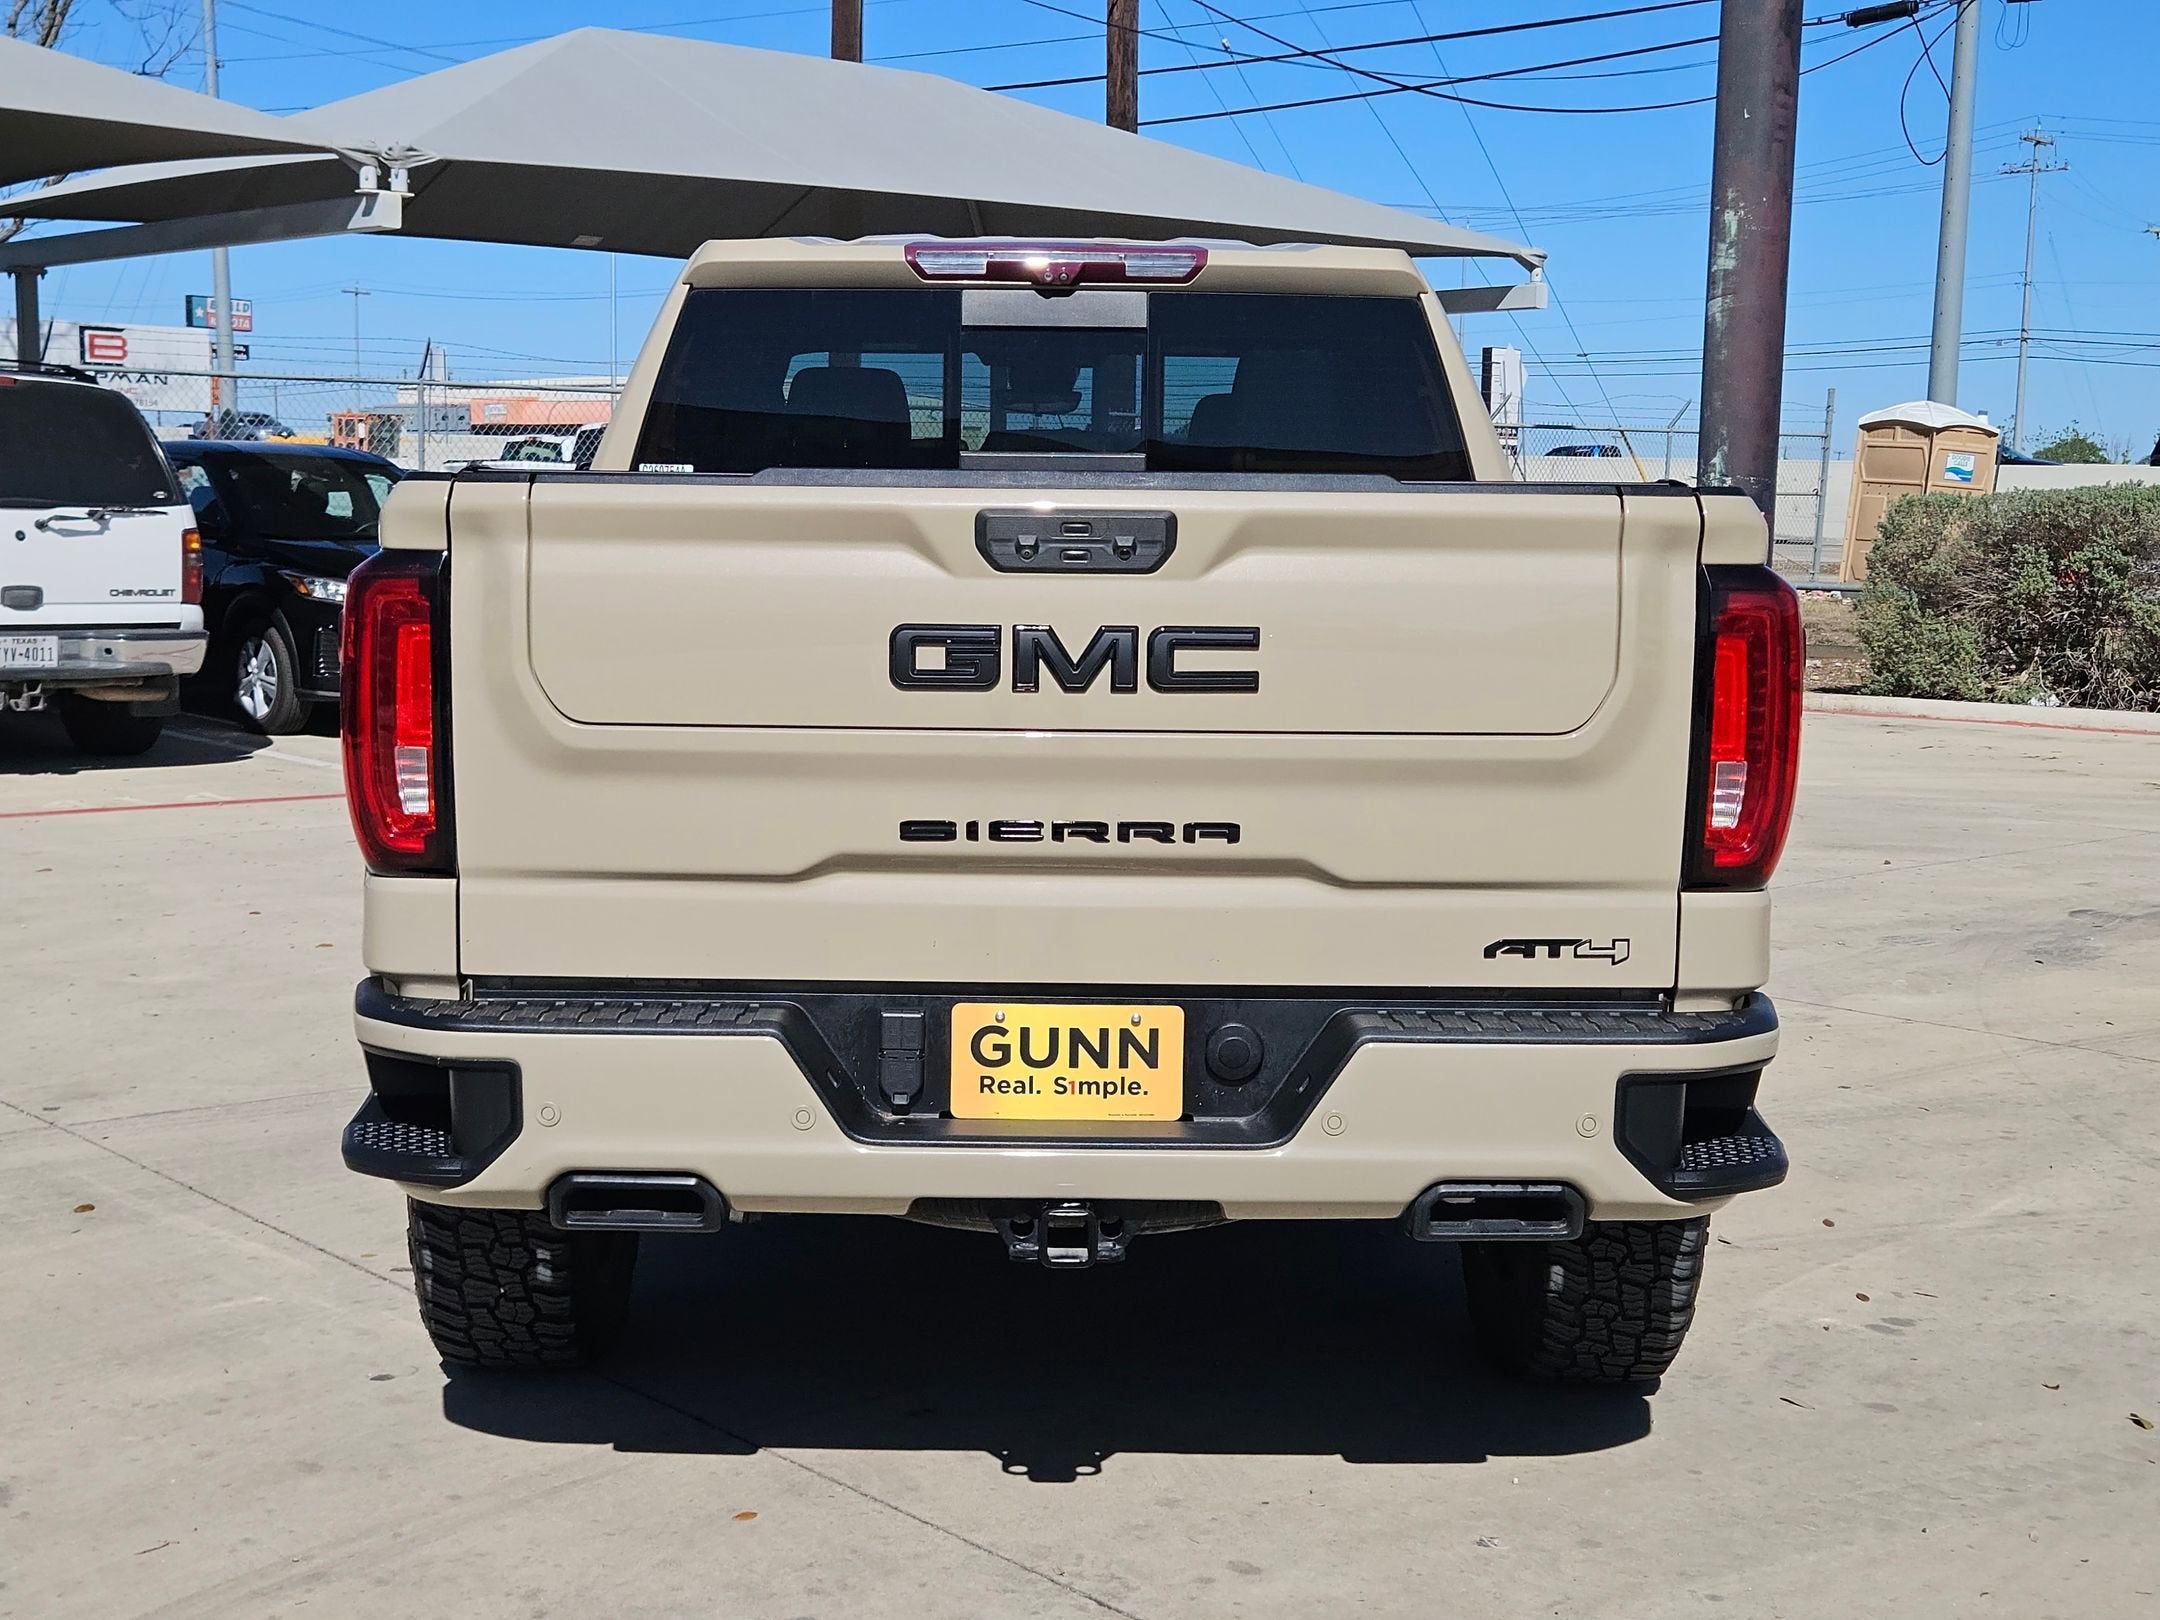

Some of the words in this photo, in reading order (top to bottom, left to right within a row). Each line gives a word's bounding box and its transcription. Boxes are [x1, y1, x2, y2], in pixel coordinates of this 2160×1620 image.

[109, 588, 176, 598] CHEVROLET
[0, 647, 54, 662] YV-4011
[889, 623, 1260, 694] GMC
[899, 819, 1241, 845] SIERRA
[1483, 938, 1630, 966] AT4
[970, 1025, 1160, 1070] GUNN
[979, 1075, 1042, 1095] Real.
